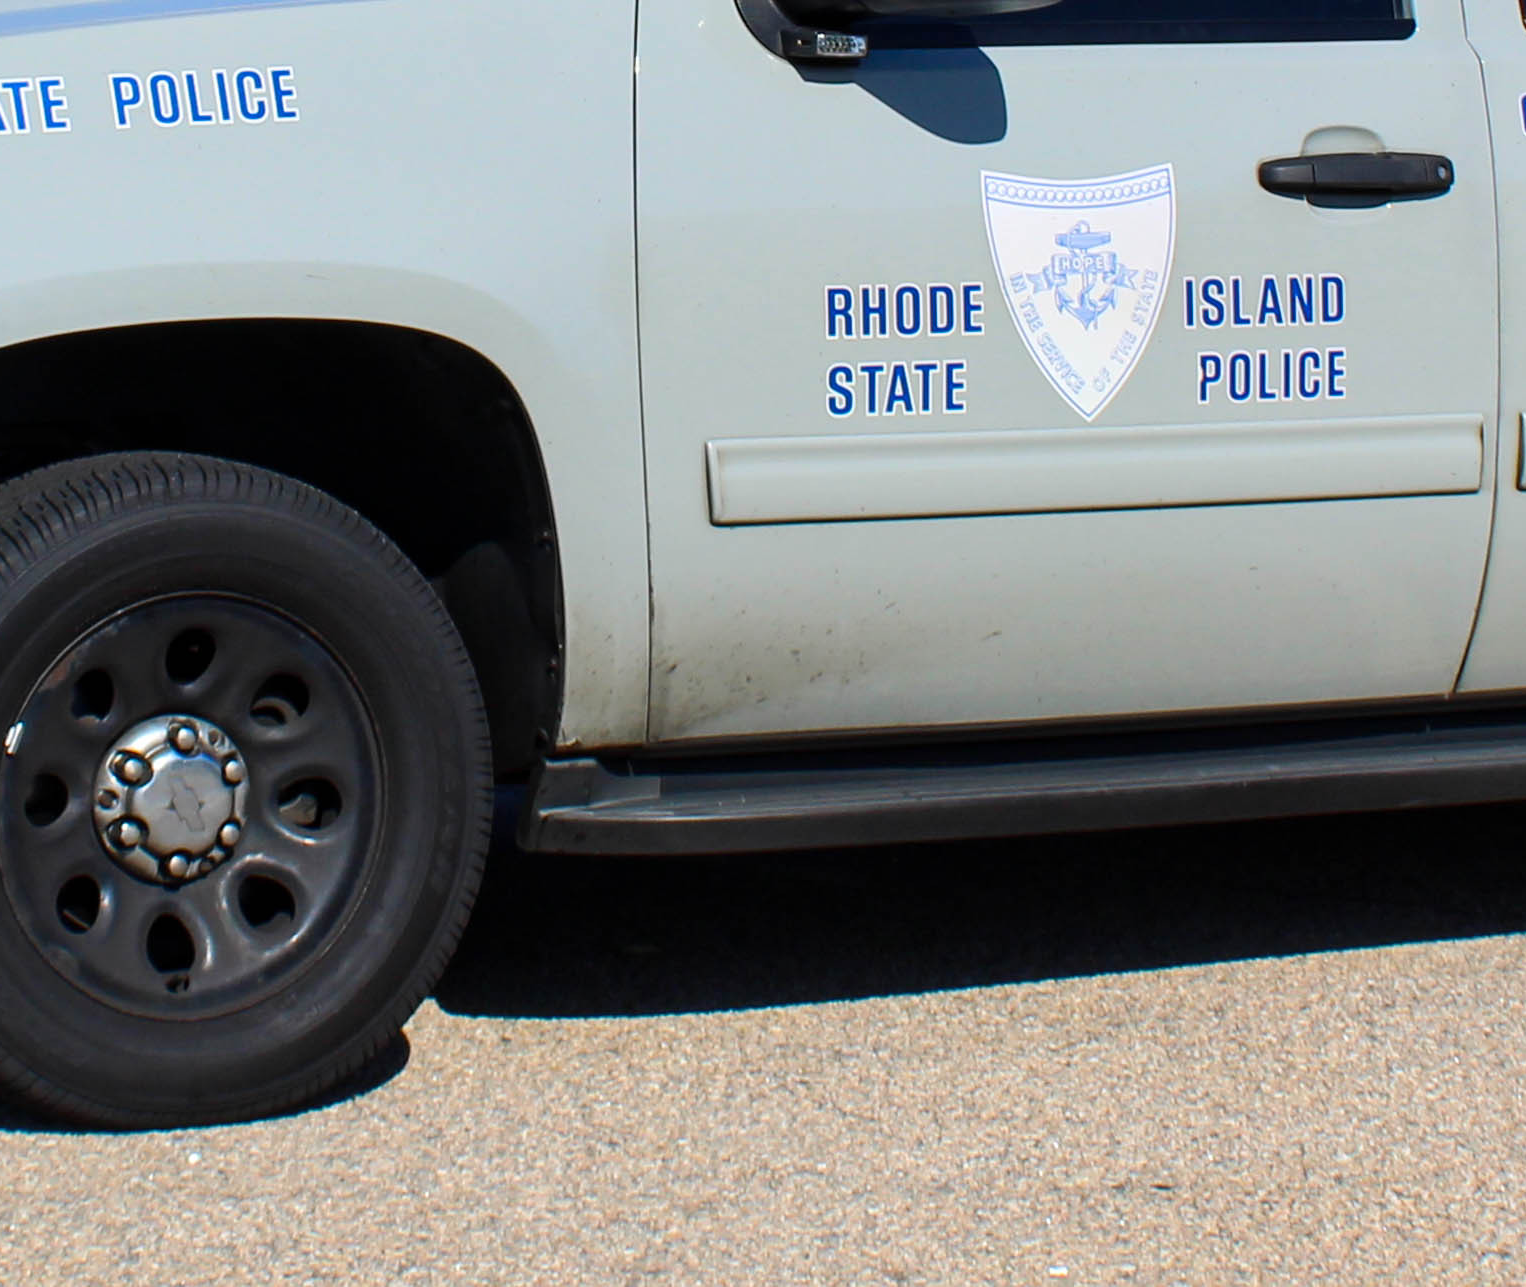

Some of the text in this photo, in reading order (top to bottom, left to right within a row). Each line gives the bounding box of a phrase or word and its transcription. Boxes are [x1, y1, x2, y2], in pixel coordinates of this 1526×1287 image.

[110, 67, 299, 128] POLICE
[1060, 255, 1106, 271] HOPE
[825, 275, 1345, 338] RHODE ISLAND
[1009, 269, 1159, 395] IN THE SERVICE OF THE STATE
[827, 348, 1346, 416] STATE POLICE
